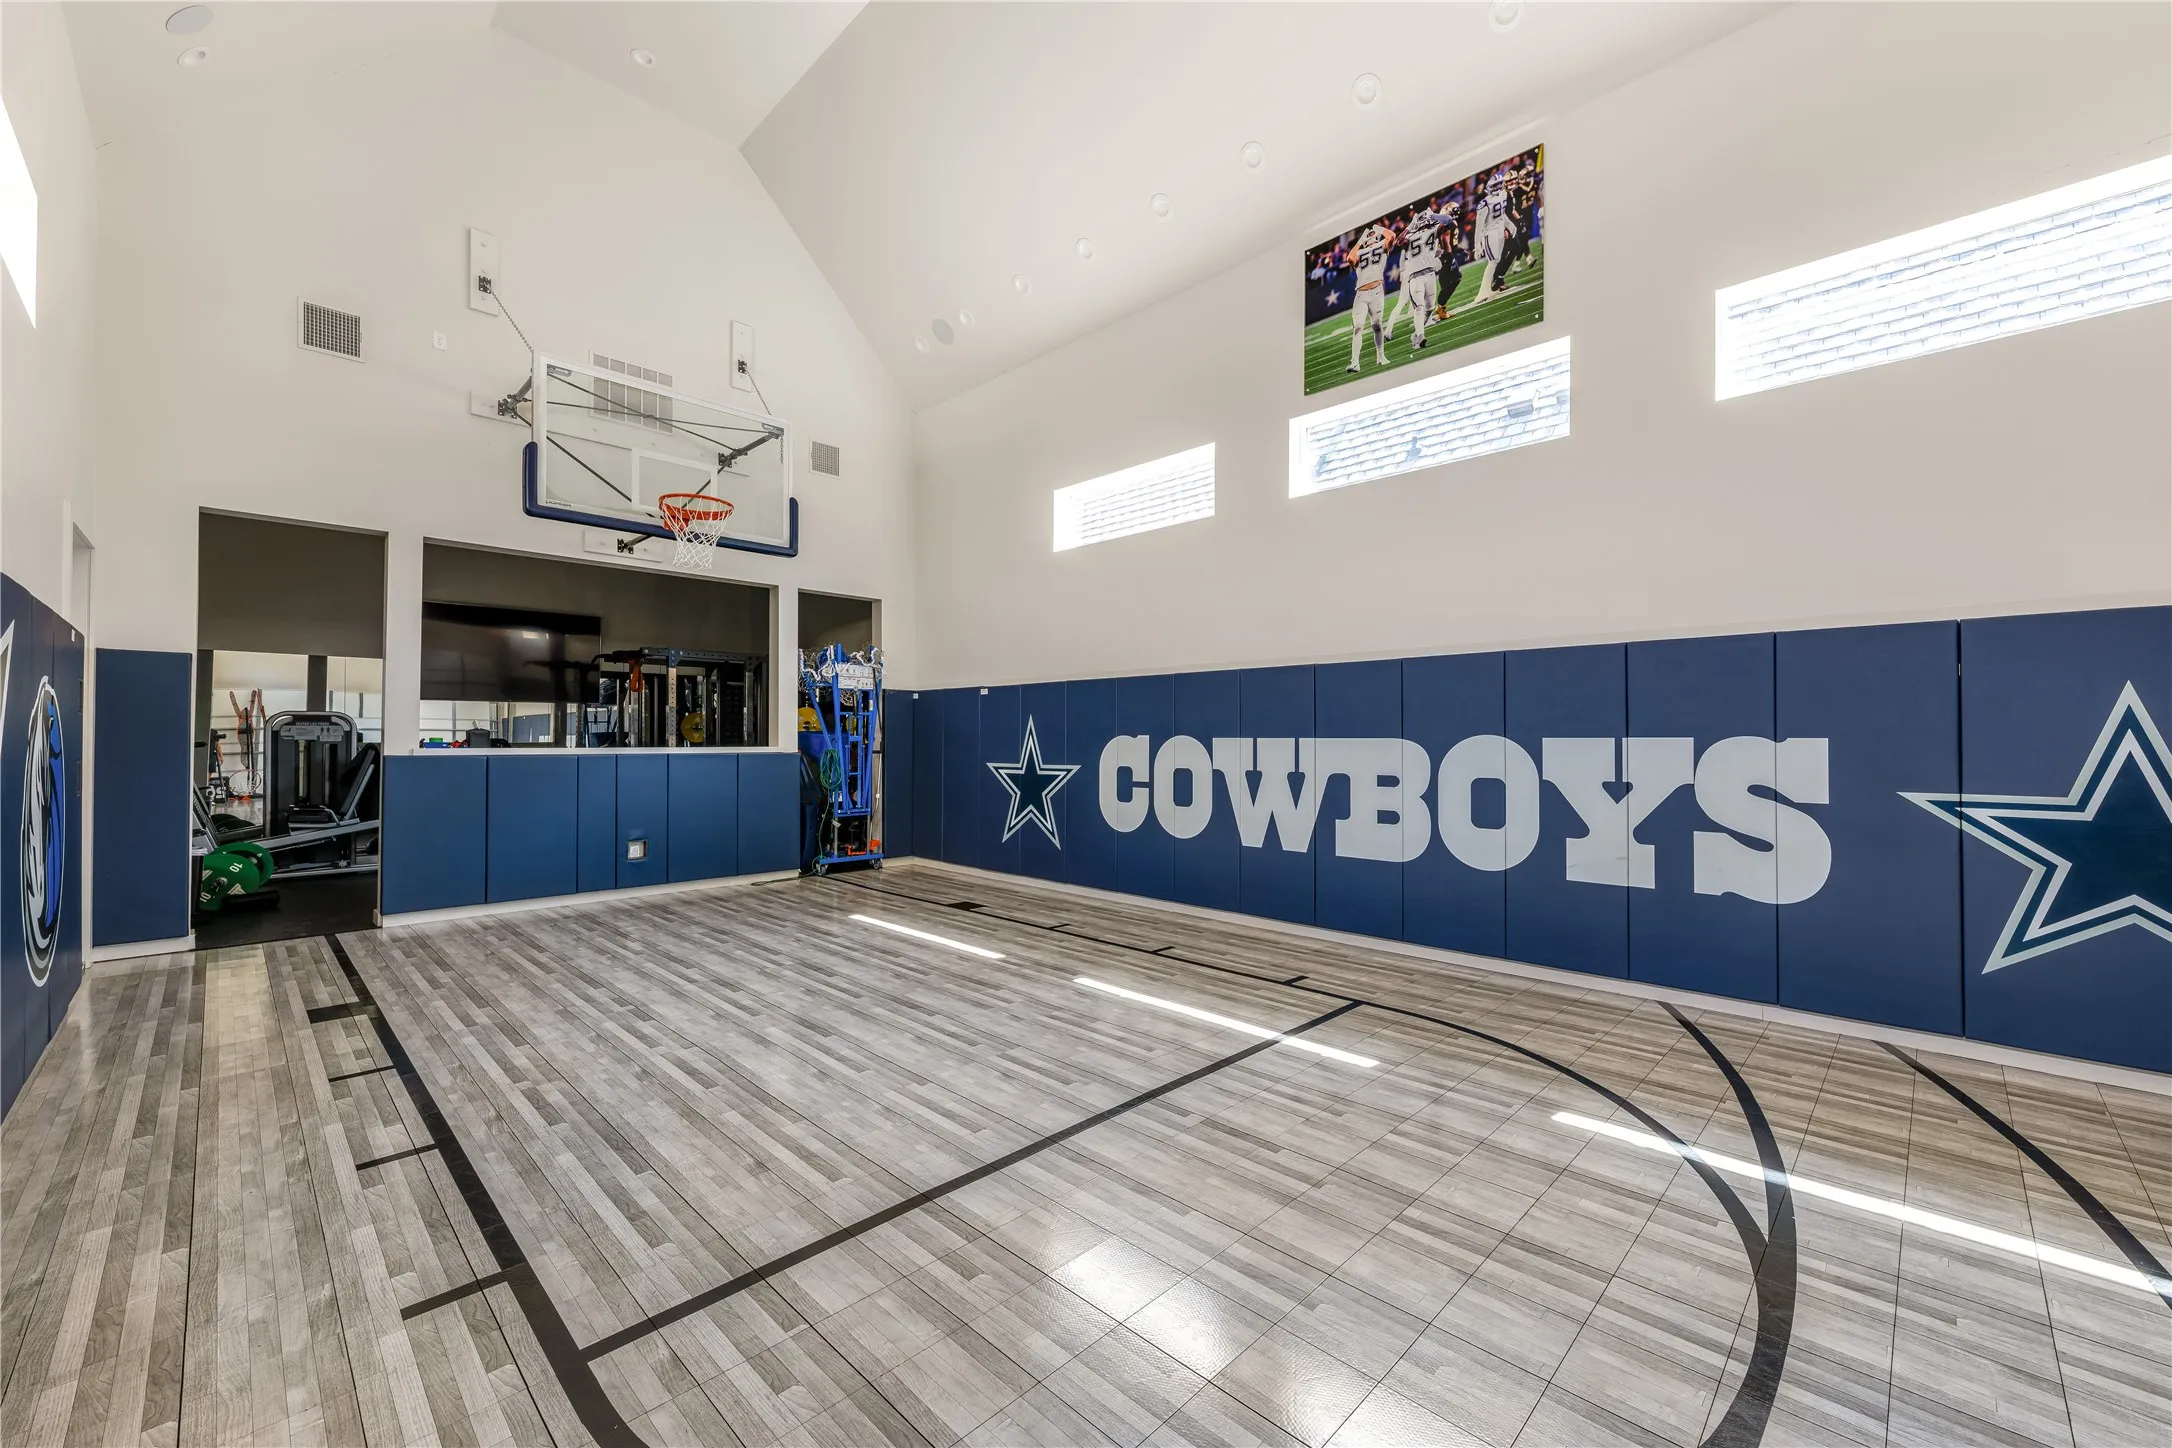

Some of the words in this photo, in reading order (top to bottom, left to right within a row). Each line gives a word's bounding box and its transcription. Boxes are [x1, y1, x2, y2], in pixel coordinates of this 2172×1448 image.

[1410, 232, 1435, 257] 54
[1360, 245, 1383, 269] 55
[1099, 734, 1832, 905] COWBOYS
[229, 862, 243, 873] 10
